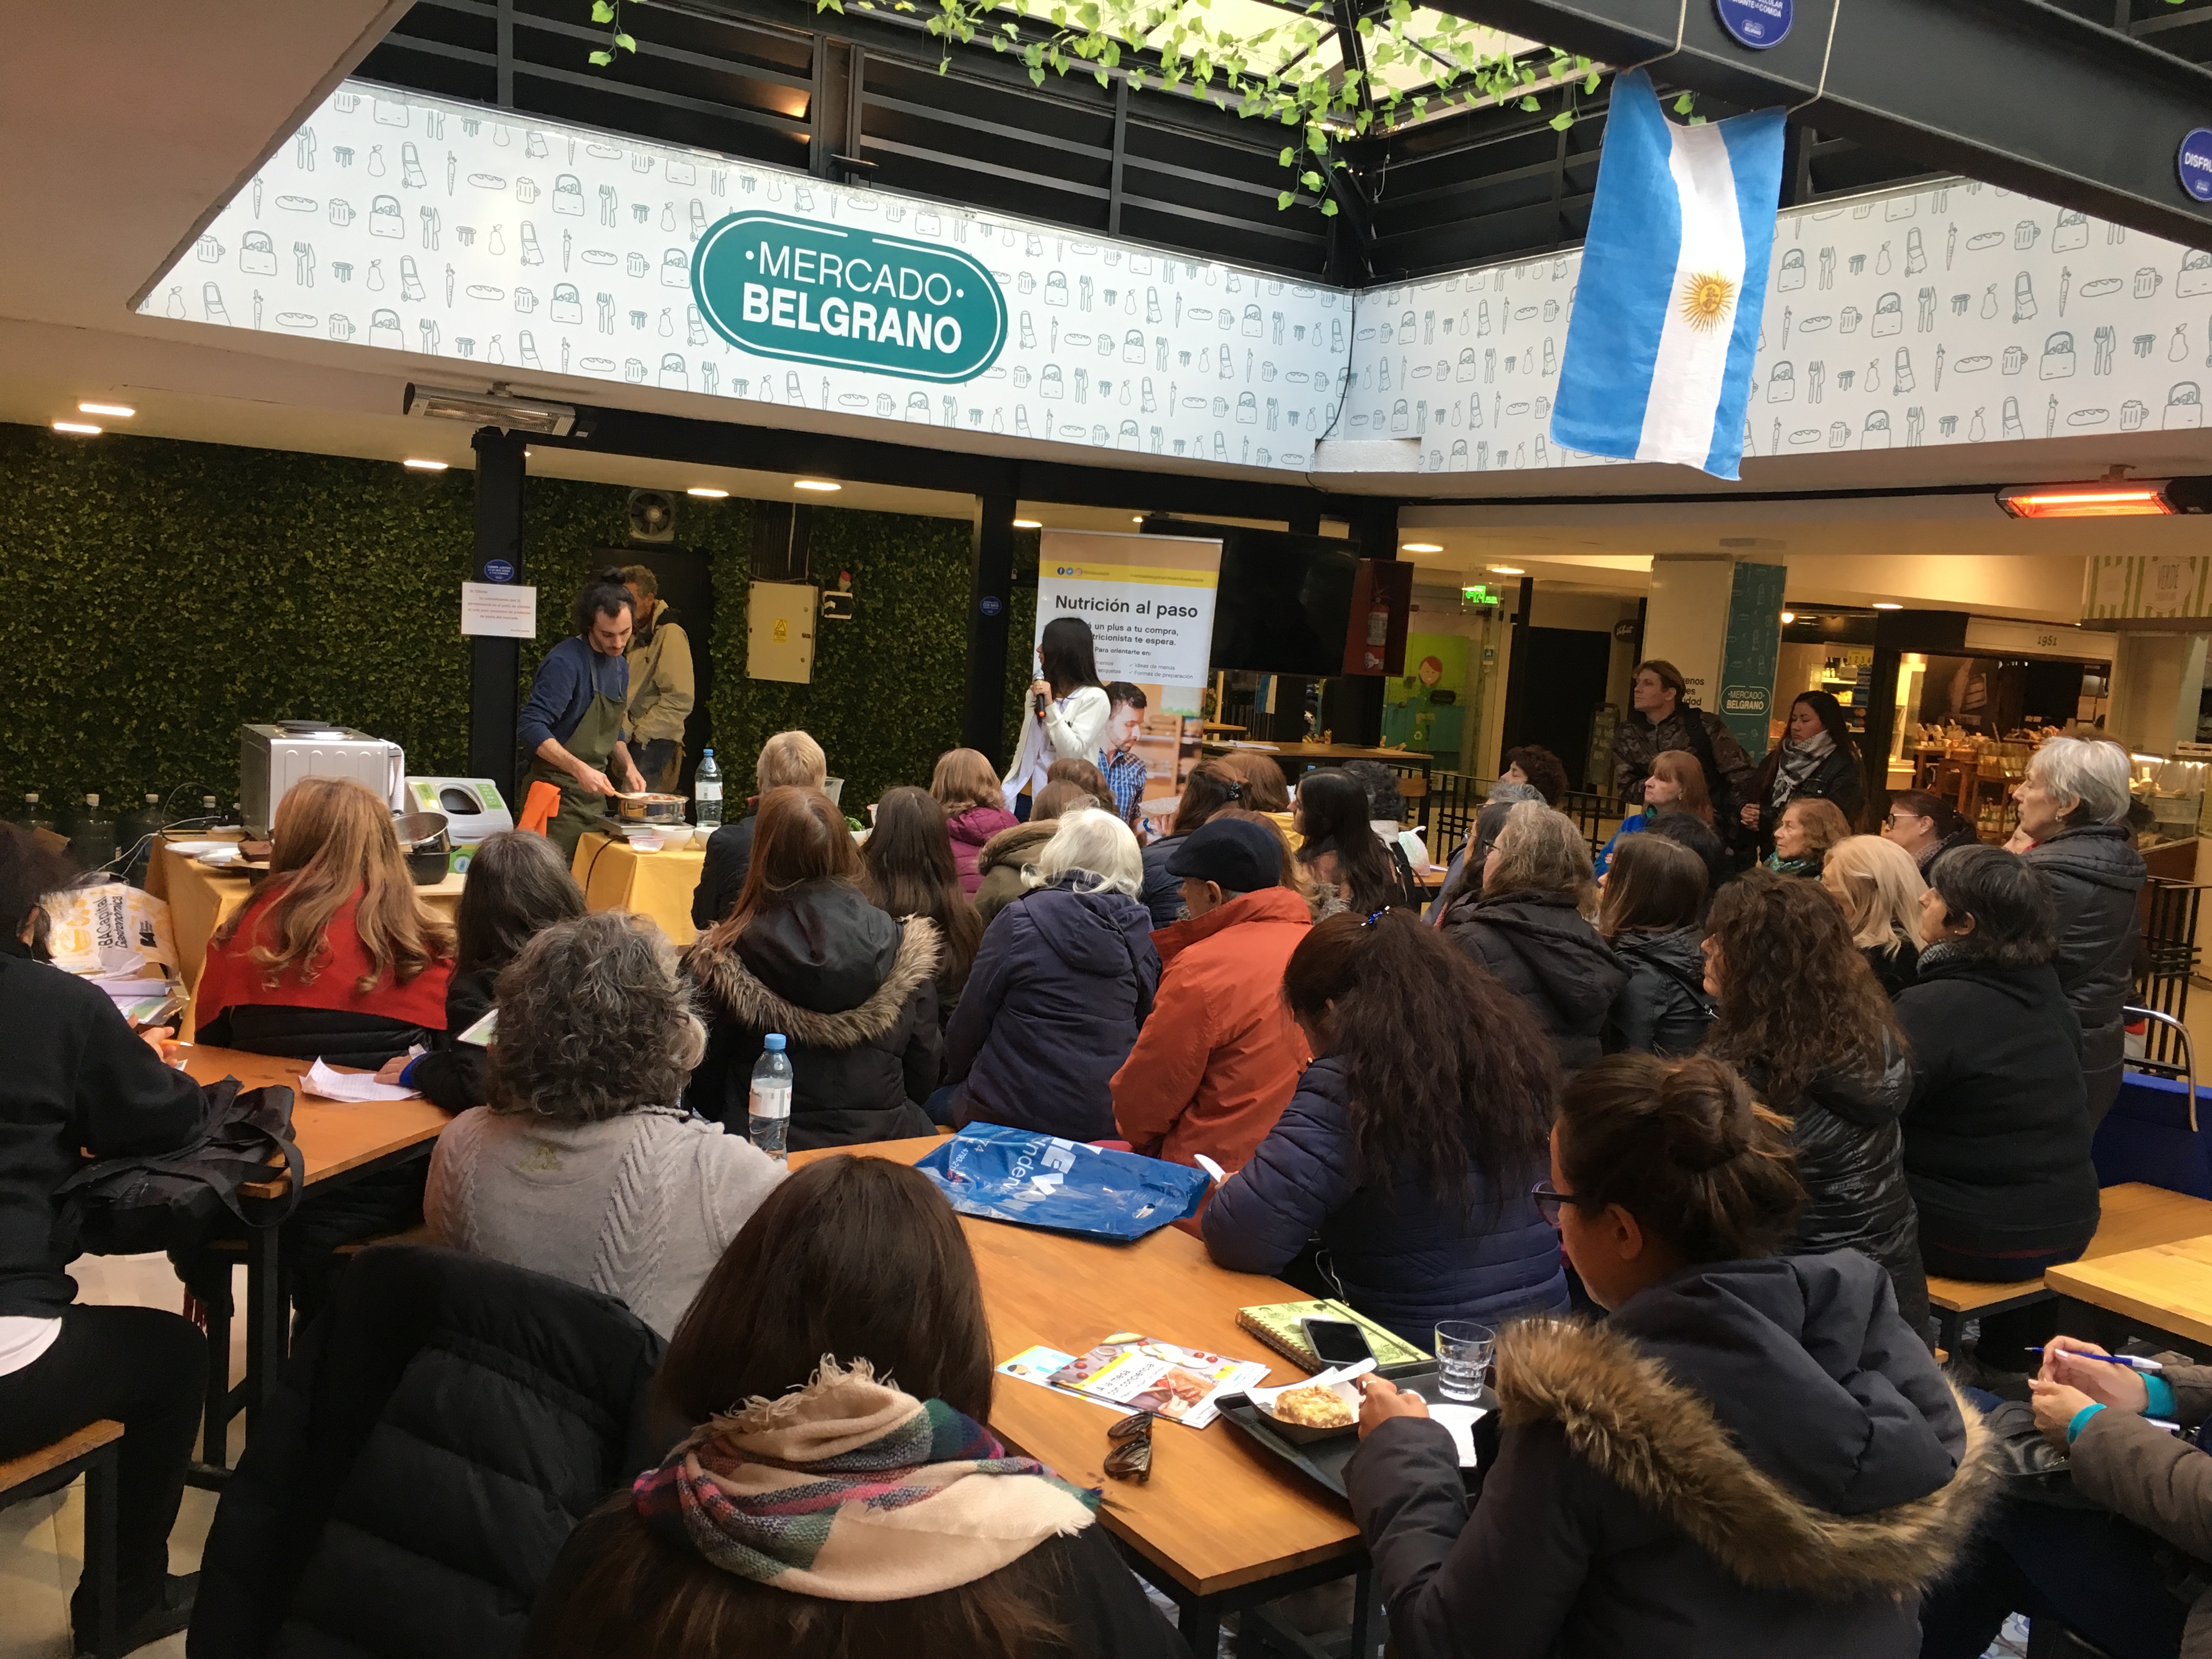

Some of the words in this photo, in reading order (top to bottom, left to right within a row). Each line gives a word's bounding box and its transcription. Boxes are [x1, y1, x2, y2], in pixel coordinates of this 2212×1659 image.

[1759, 4, 1781, 18] COMIDA
[760, 241, 952, 306] MERCADO
[742, 282, 962, 354] BELGRANO
[1056, 595, 1130, 613] Nutrición
[1136, 600, 1151, 614] al
[1156, 604, 1198, 619] paso
[1107, 623, 1124, 632] plus
[1144, 627, 1179, 636] compra,
[1092, 633, 1132, 642] tricionista
[2037, 635, 2057, 647] 1951
[1729, 690, 1763, 699] MERCADO
[1726, 699, 1764, 710] BELGRANO
[93, 895, 113, 947] BACapital
[950, 1147, 969, 1172] 4793-21
[1104, 1378, 1114, 1387] la
[1112, 1369, 1131, 1383] mesa
[1107, 1385, 1121, 1396] con
